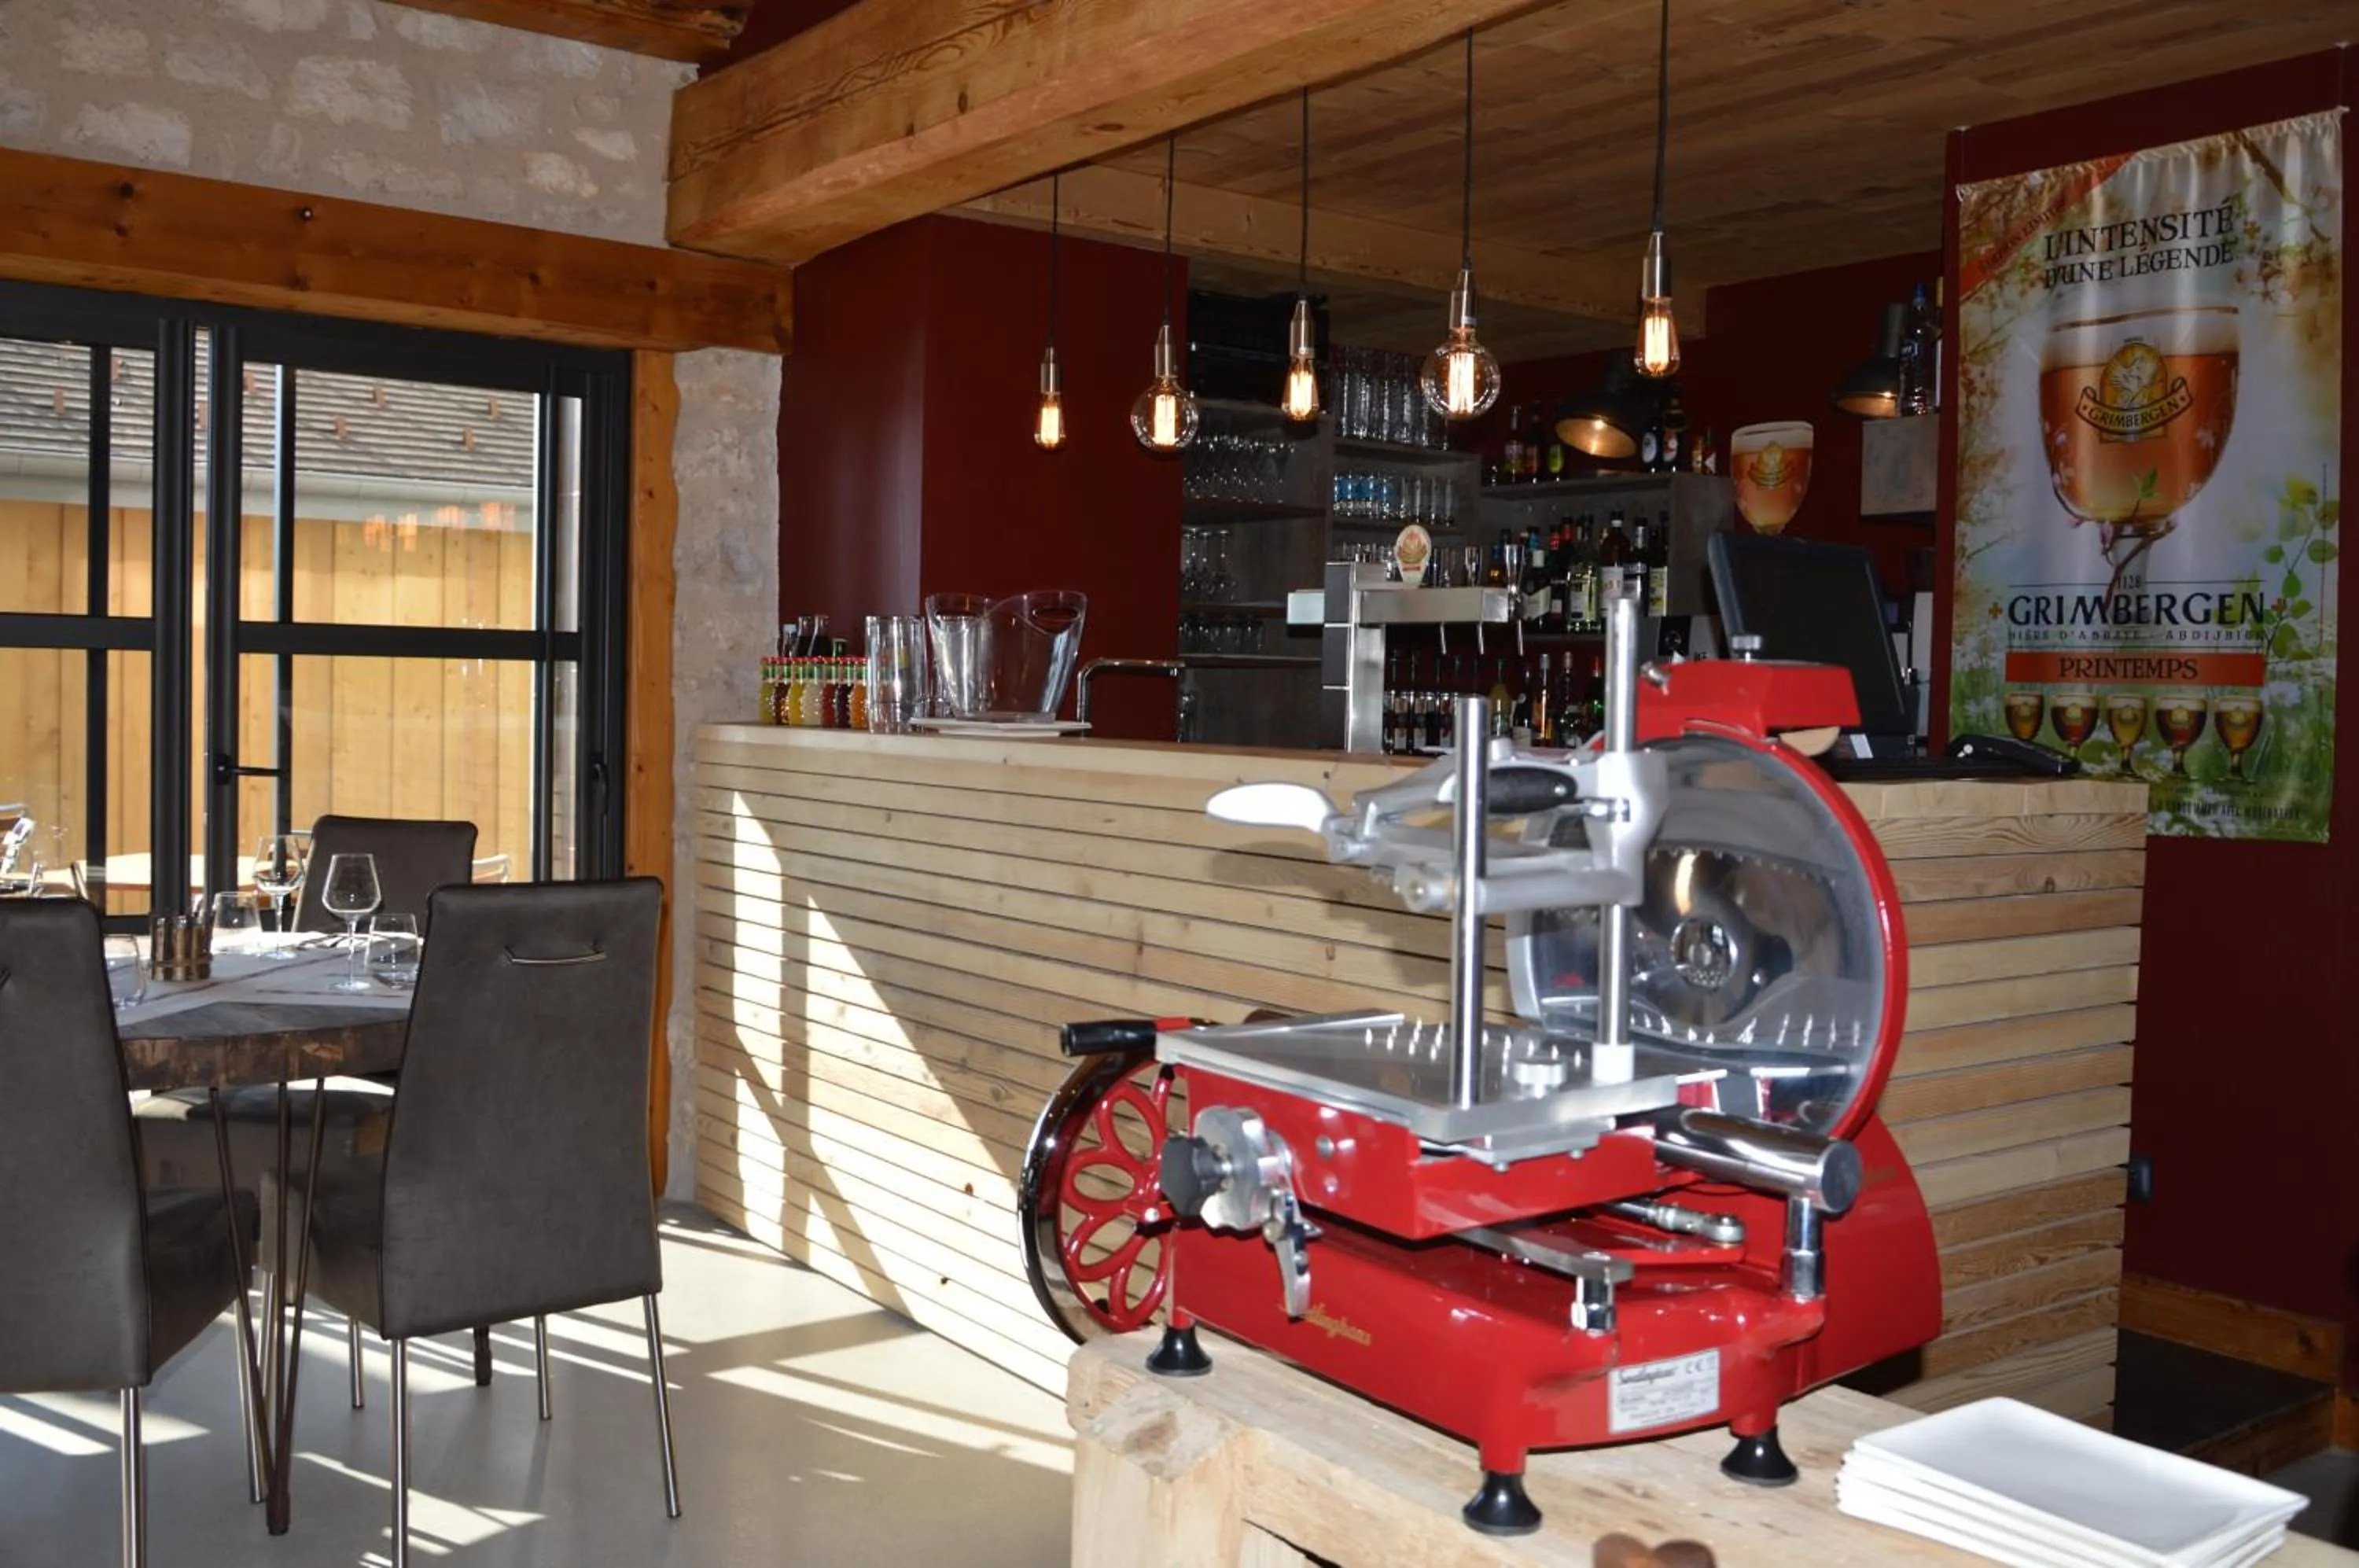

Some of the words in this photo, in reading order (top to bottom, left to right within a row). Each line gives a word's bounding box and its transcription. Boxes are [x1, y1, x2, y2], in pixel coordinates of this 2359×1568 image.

[2044, 198, 2235, 261] L'INTENSITÉ
[2044, 260, 2114, 289] D'UNE
[2120, 243, 2235, 278] LÉGENDE
[2088, 397, 2181, 428] GRIMBERGEN
[2116, 575, 2142, 589] 1128
[2008, 591, 2265, 626] GRIMBERGEN
[2057, 657, 2199, 680] PRINTEMPS
